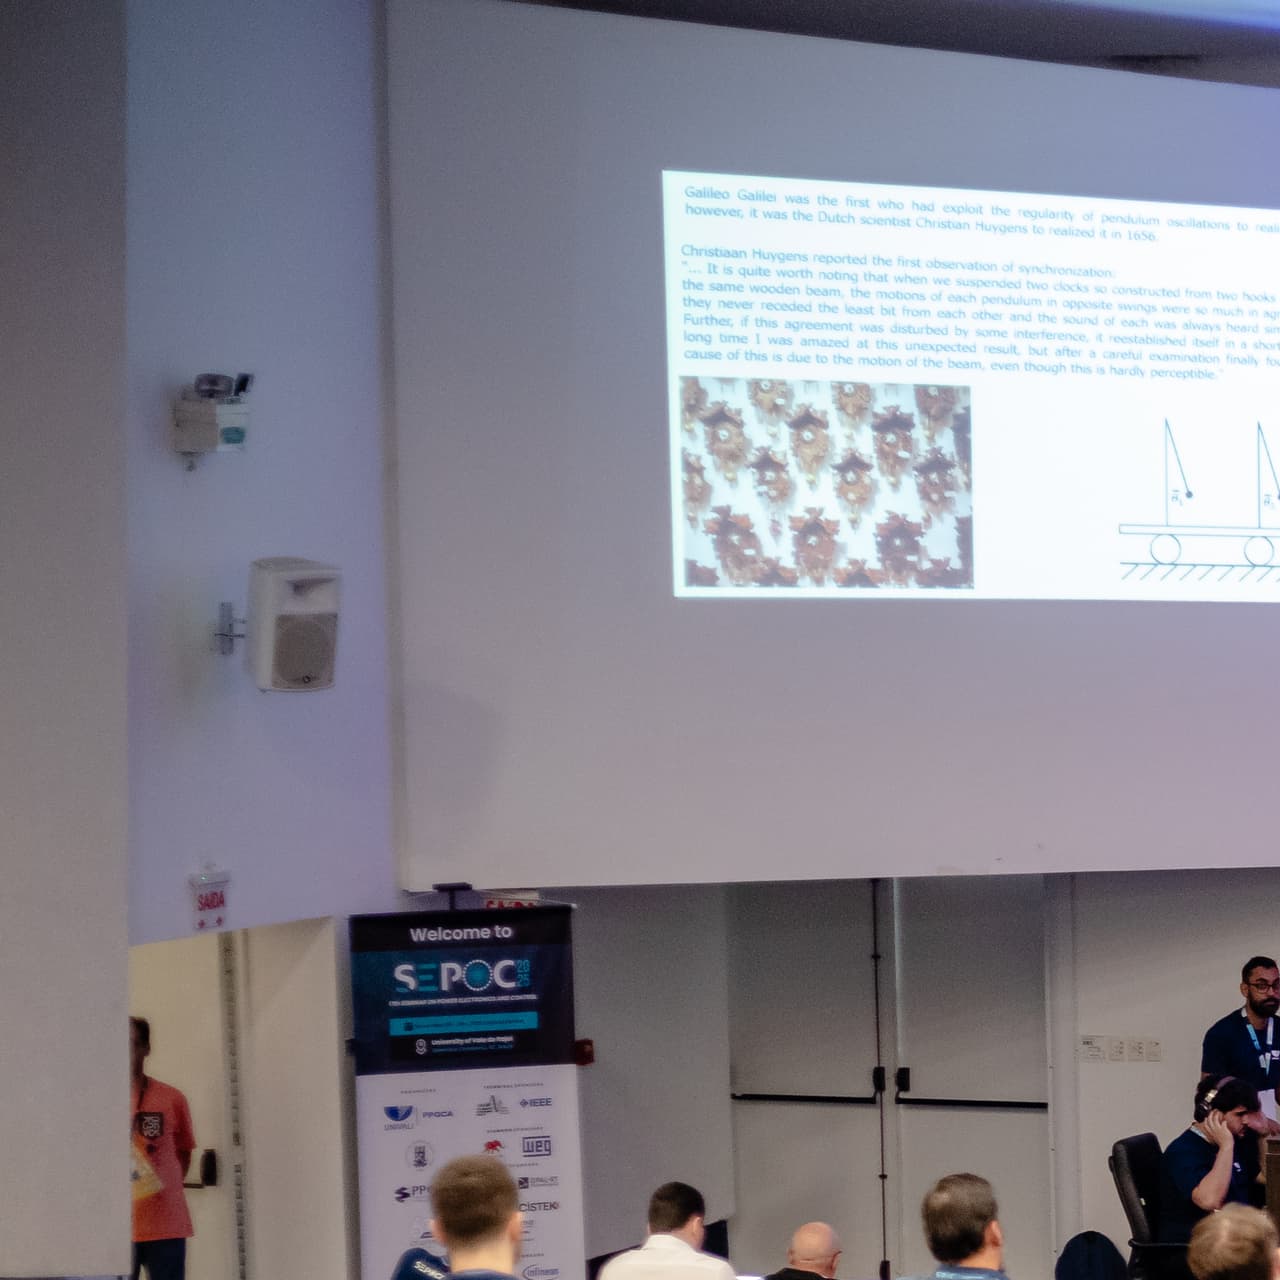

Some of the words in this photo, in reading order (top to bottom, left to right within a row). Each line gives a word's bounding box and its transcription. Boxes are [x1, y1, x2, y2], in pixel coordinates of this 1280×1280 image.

[410, 926, 491, 942] Welcome
[495, 925, 513, 939] to
[393, 959, 516, 993] SEPOC
[529, 1098, 552, 1107] IEEE
